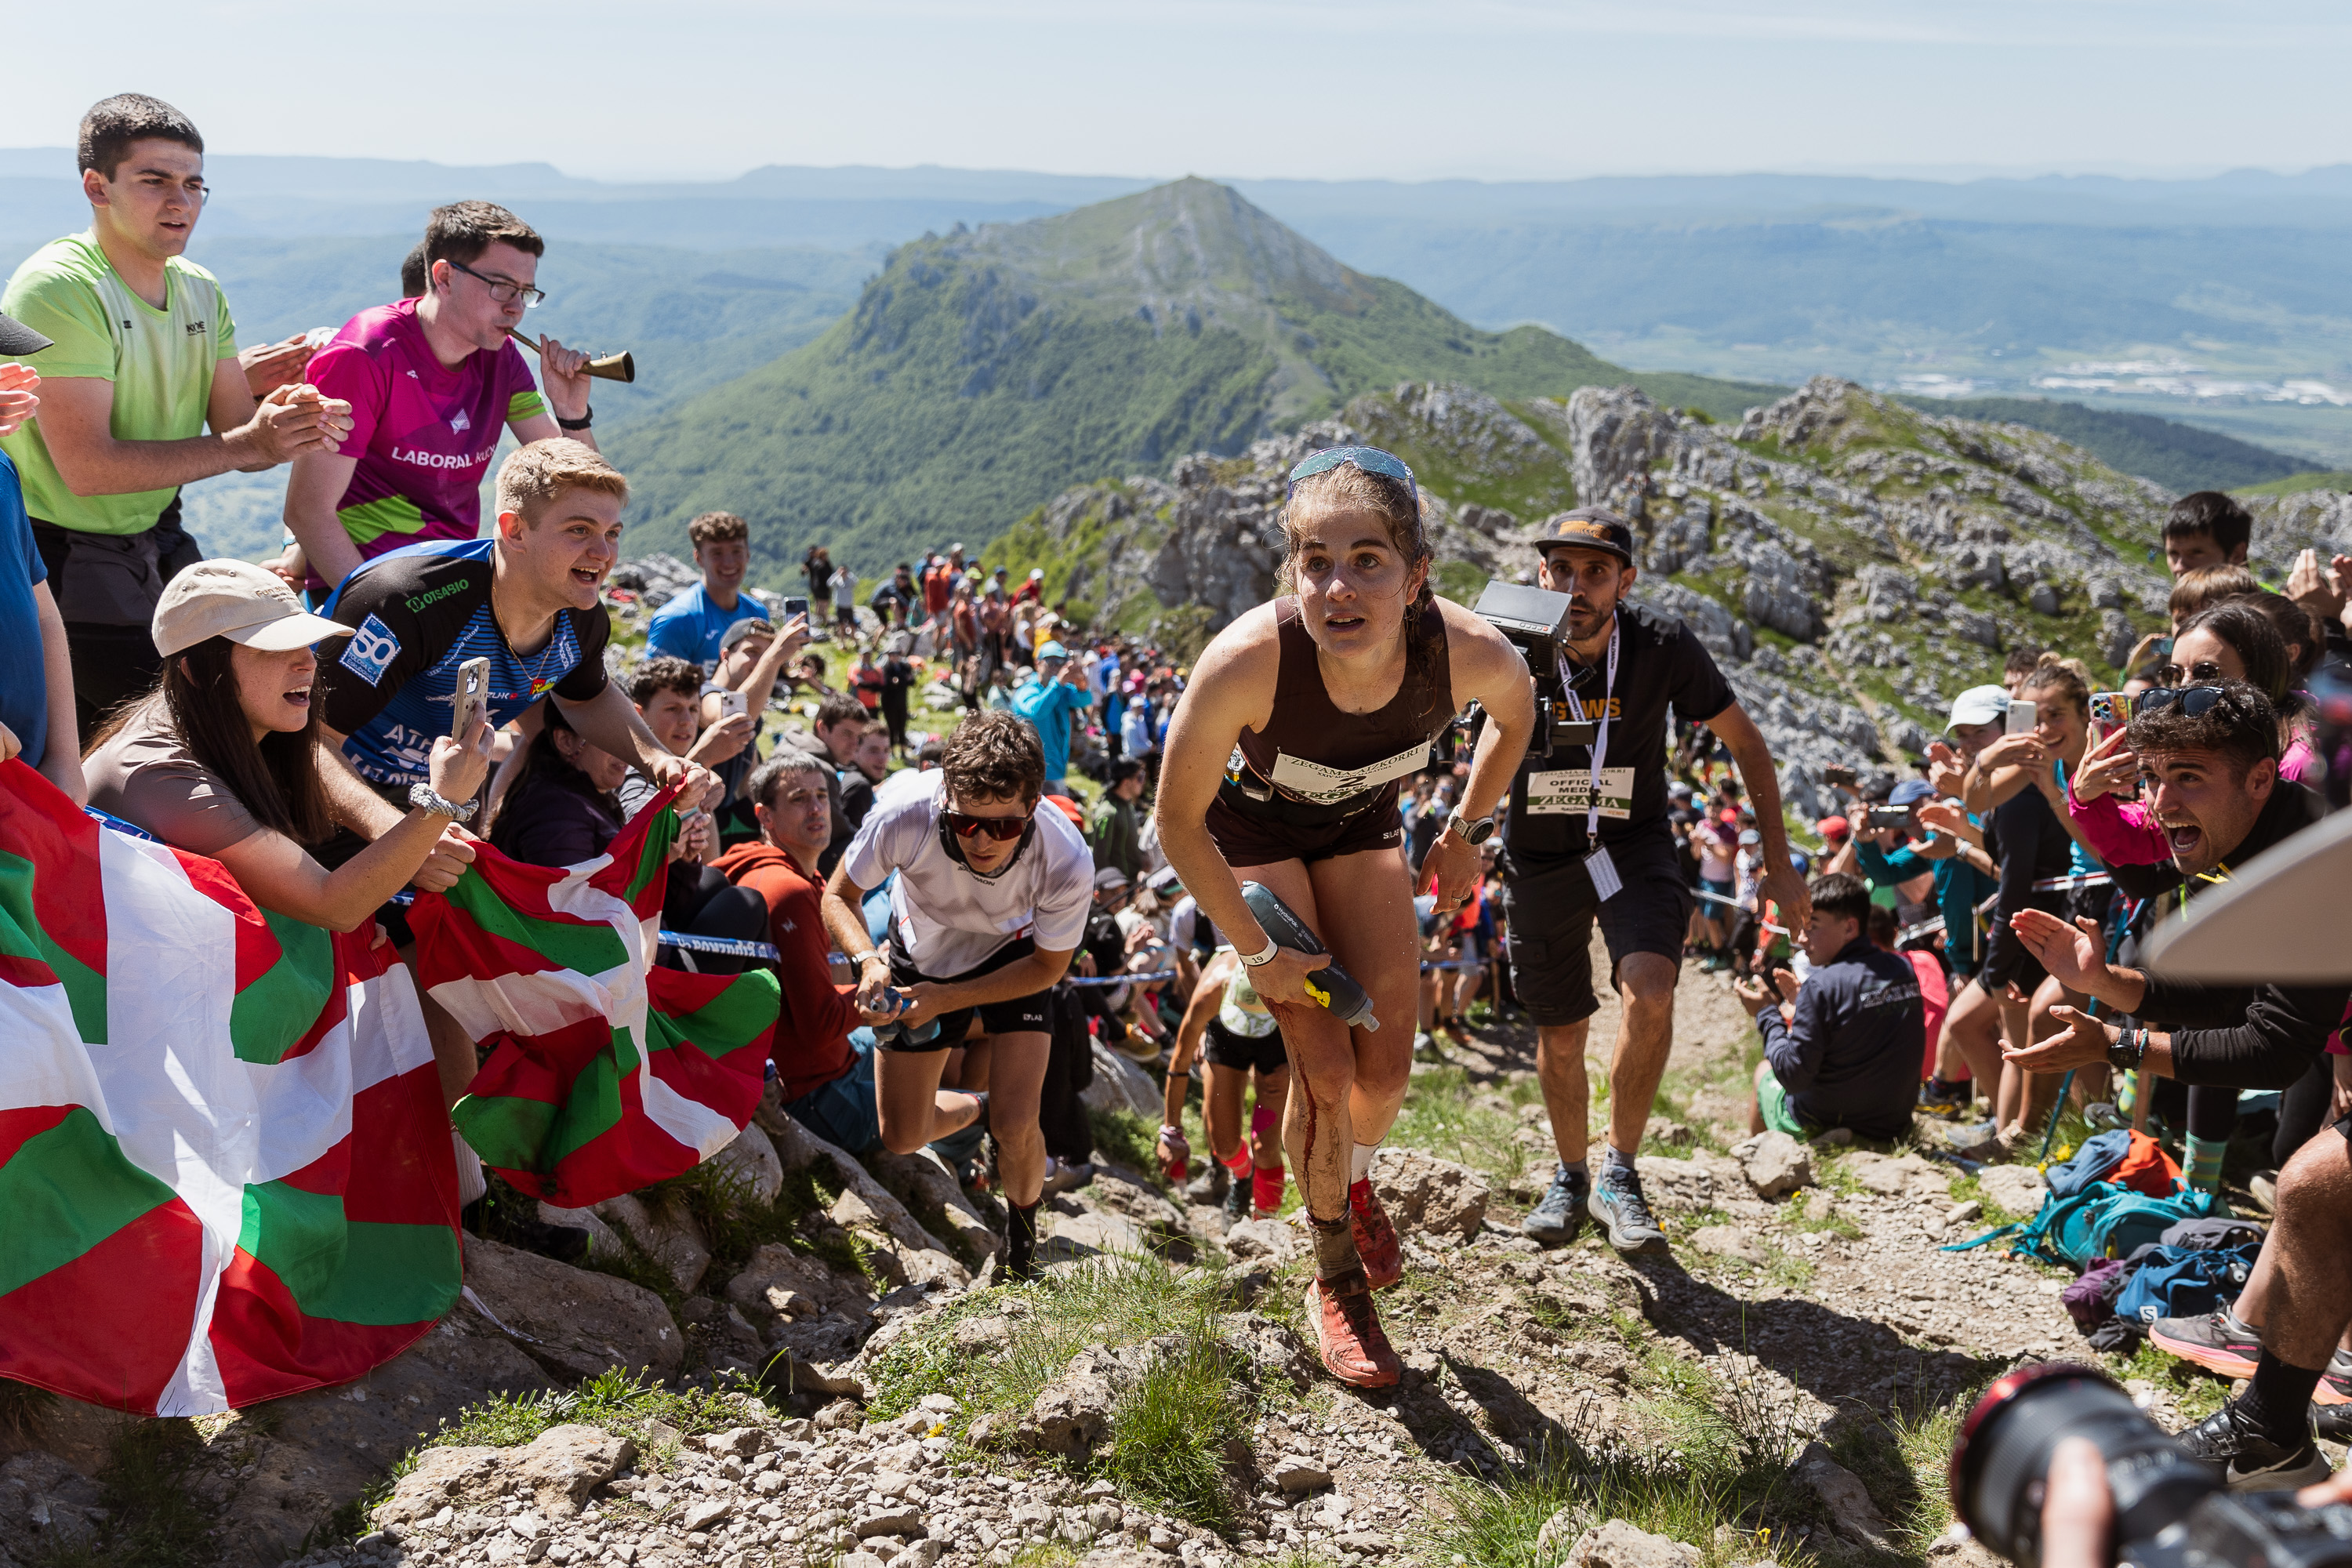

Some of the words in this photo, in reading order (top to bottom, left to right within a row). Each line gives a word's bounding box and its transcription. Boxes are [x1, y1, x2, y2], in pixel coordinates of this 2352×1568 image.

[391, 446, 473, 470] LABORAL
[423, 579, 469, 604] OTSABIO
[370, 619, 383, 631] 1972
[352, 626, 396, 666] 50
[347, 659, 375, 681] Eskubaloia
[348, 652, 367, 670] TOLOSA
[1290, 747, 1420, 776] ZEGAMA-AIZKORRI
[1327, 784, 1369, 793] MALEN
[1334, 775, 1367, 789] 2
[1539, 796, 1620, 808] ZEGAMA
[1278, 907, 1299, 928] HydraPak
